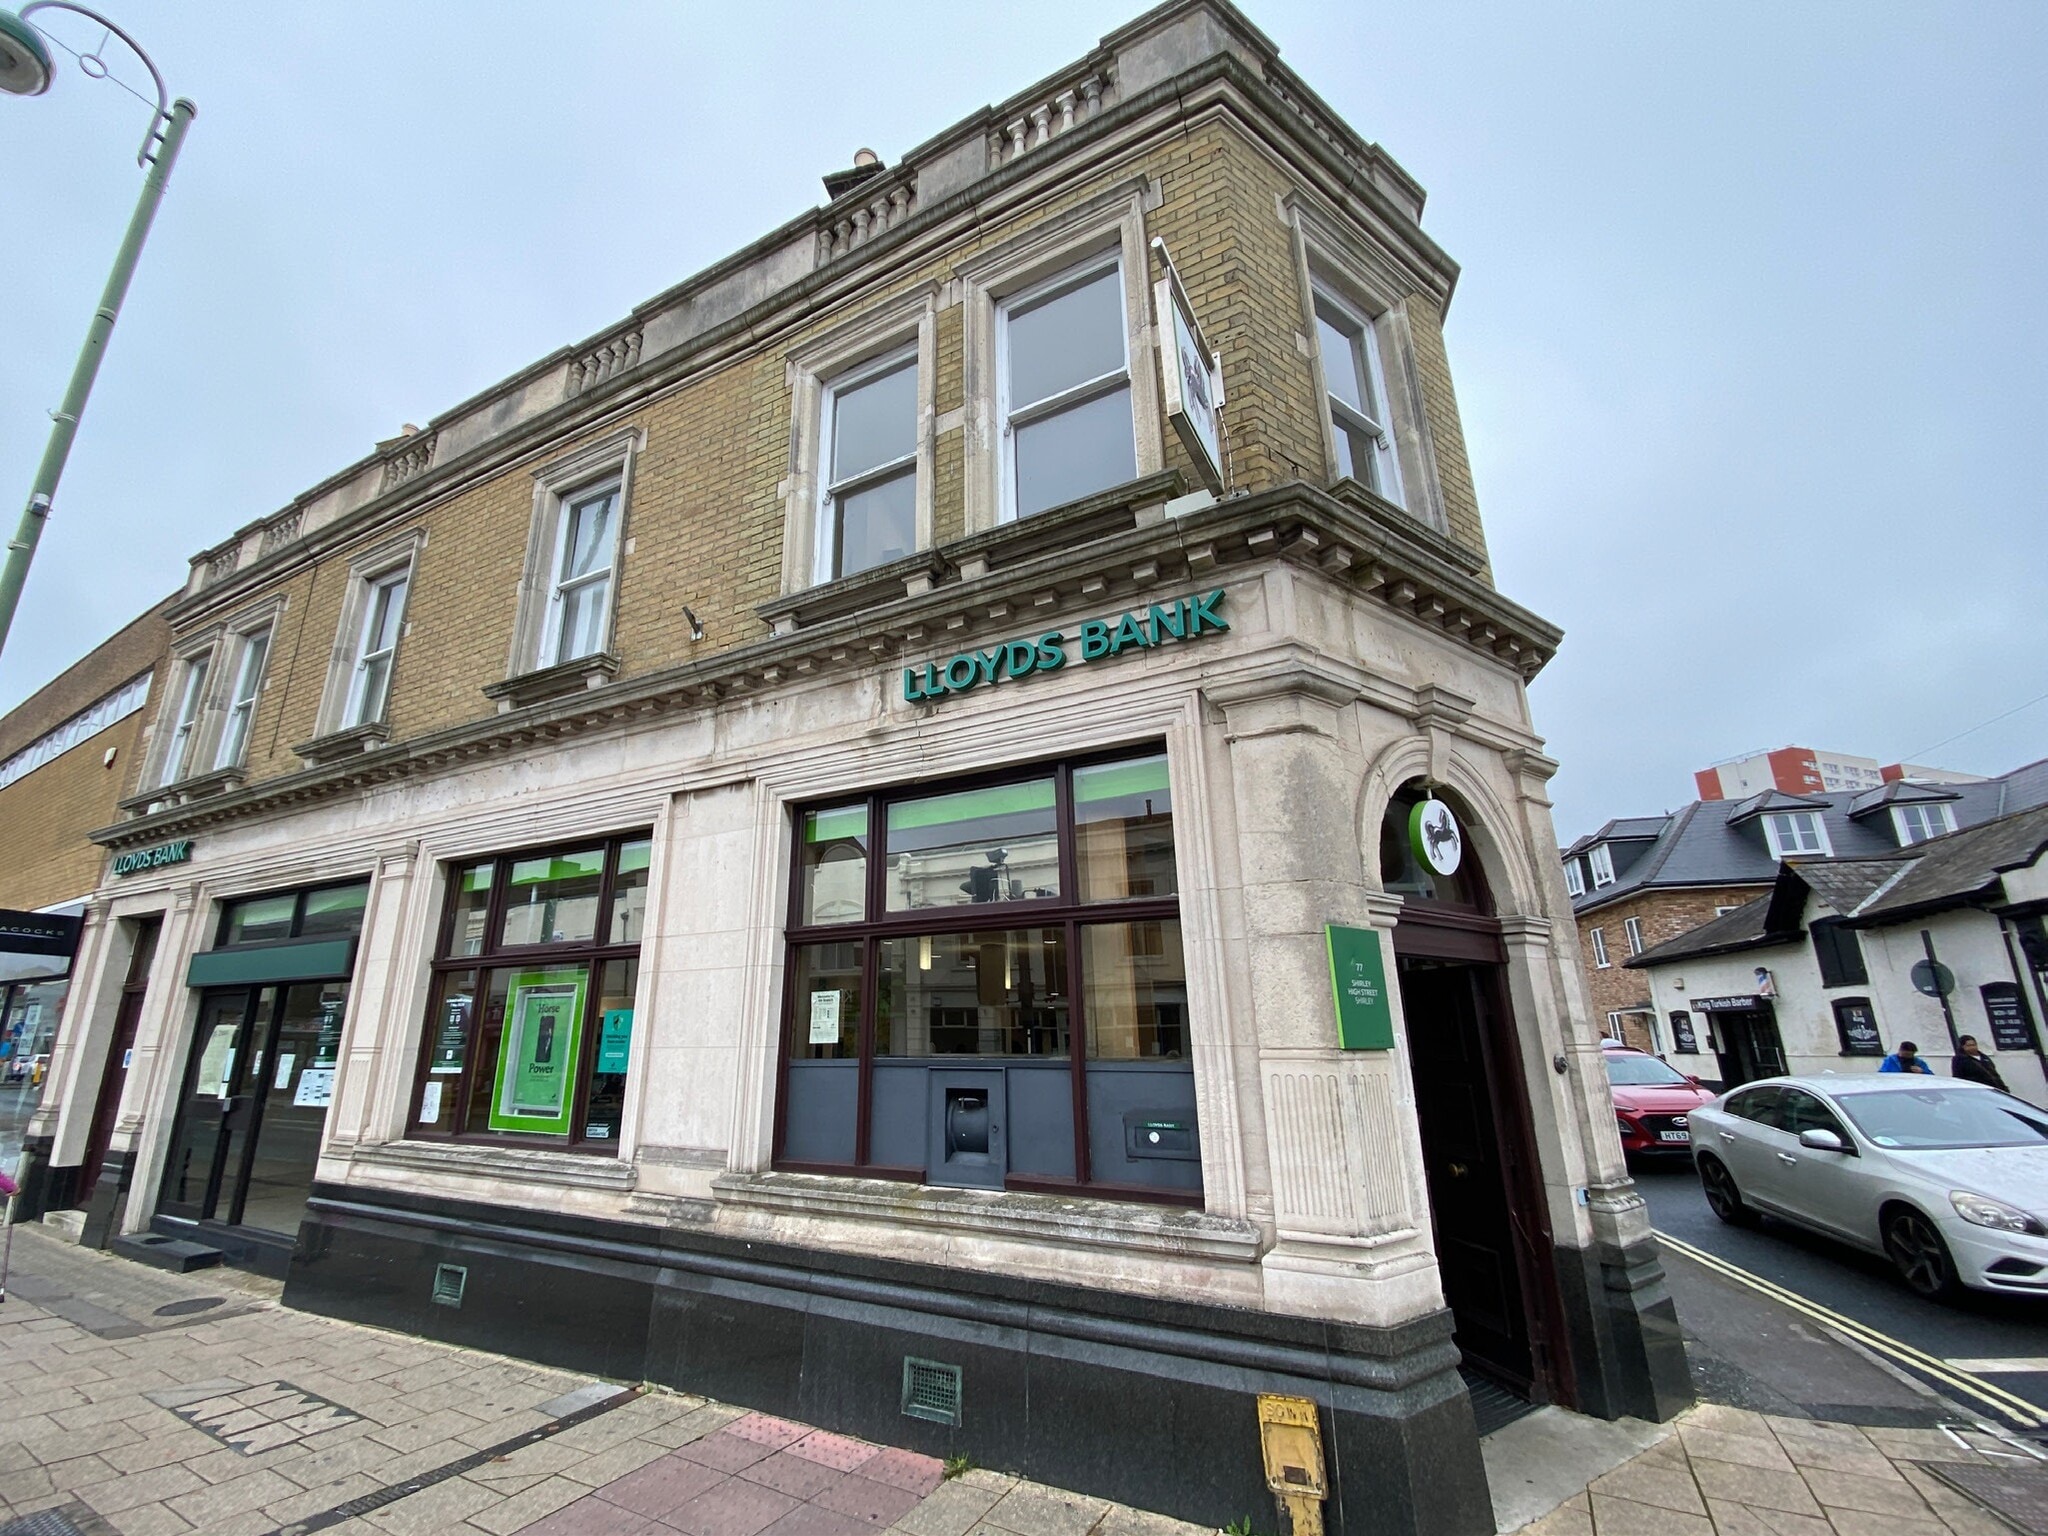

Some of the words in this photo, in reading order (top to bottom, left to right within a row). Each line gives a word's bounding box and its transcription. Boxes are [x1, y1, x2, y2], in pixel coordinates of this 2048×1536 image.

[903, 631, 1067, 701] LLOYDS
[1080, 588, 1231, 663] BANK
[113, 849, 154, 875] LLOYDS
[153, 840, 189, 866] BANK
[1355, 962, 1364, 972] 77
[1351, 979, 1371, 988] SHIRLEY
[1347, 988, 1360, 996] HIGH
[1360, 988, 1379, 997] STREET
[1355, 996, 1375, 1006] SHIRLEY
[1697, 1000, 1712, 1010] King
[1711, 998, 1731, 1009] Turkish
[1731, 997, 1753, 1008] Barber
[537, 1003, 561, 1014] Horse
[528, 1063, 554, 1074] Power
[1664, 1132, 1688, 1140] HT69
